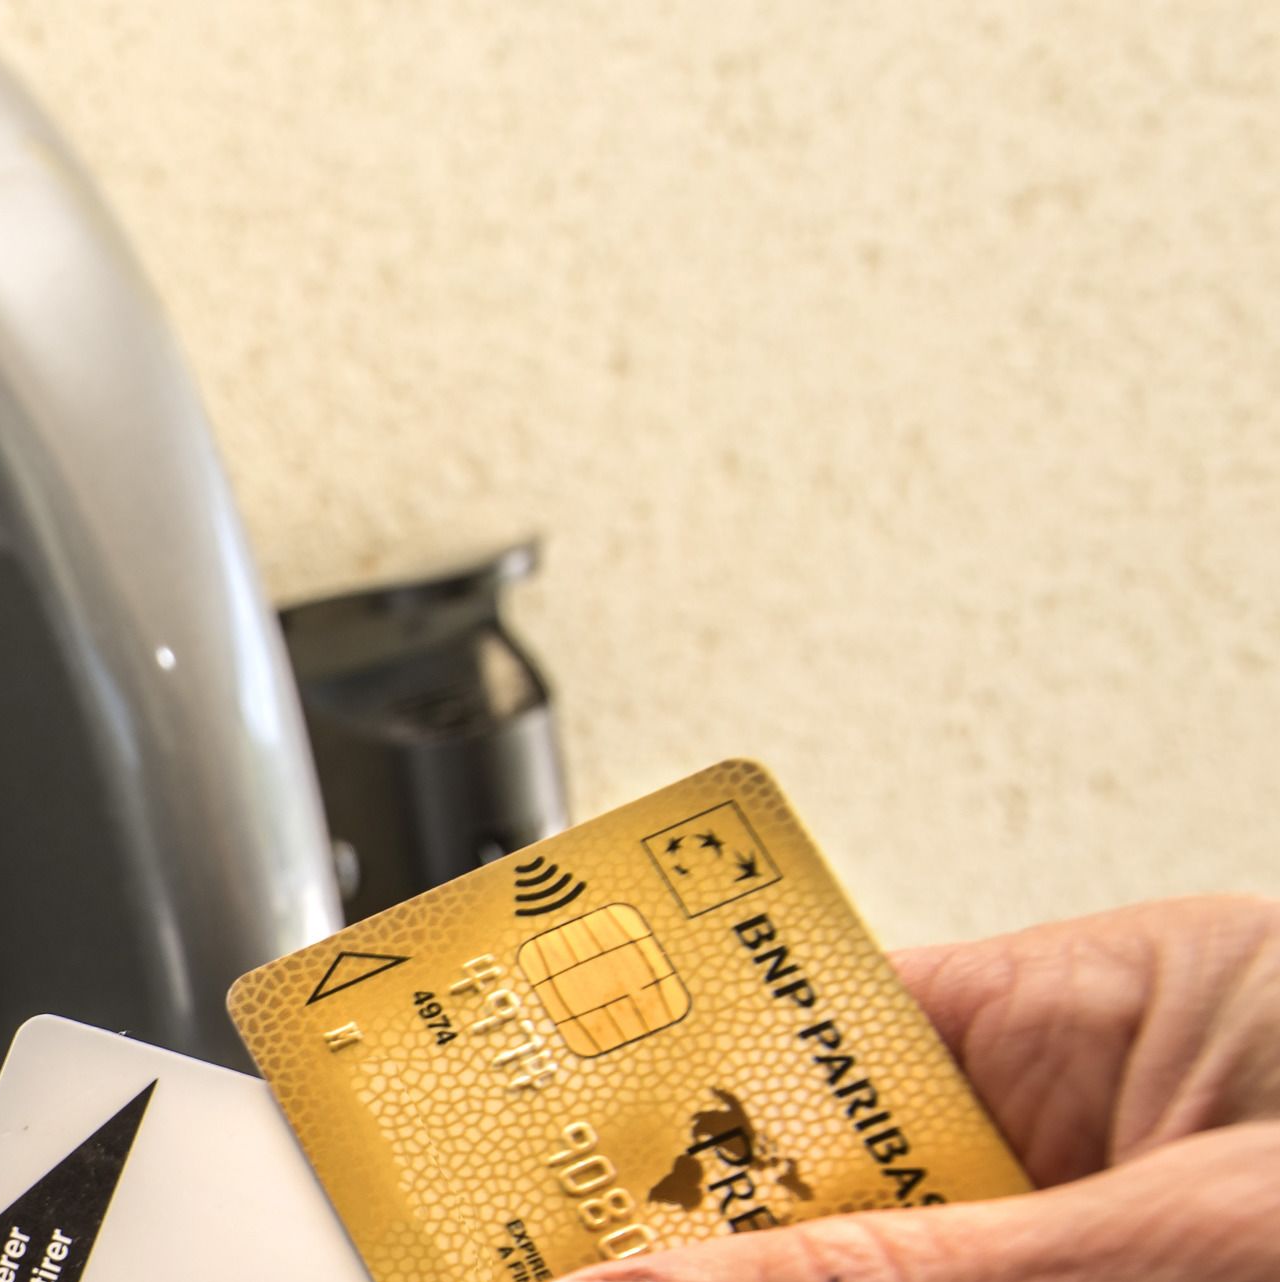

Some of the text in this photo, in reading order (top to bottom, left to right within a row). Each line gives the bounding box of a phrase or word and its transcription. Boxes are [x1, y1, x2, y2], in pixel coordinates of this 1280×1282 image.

[732, 912, 817, 1009] BNP
[413, 989, 458, 1046] 4974
[449, 953, 656, 1260] 4974 9080
[506, 1218, 553, 1282] EXPIRE
